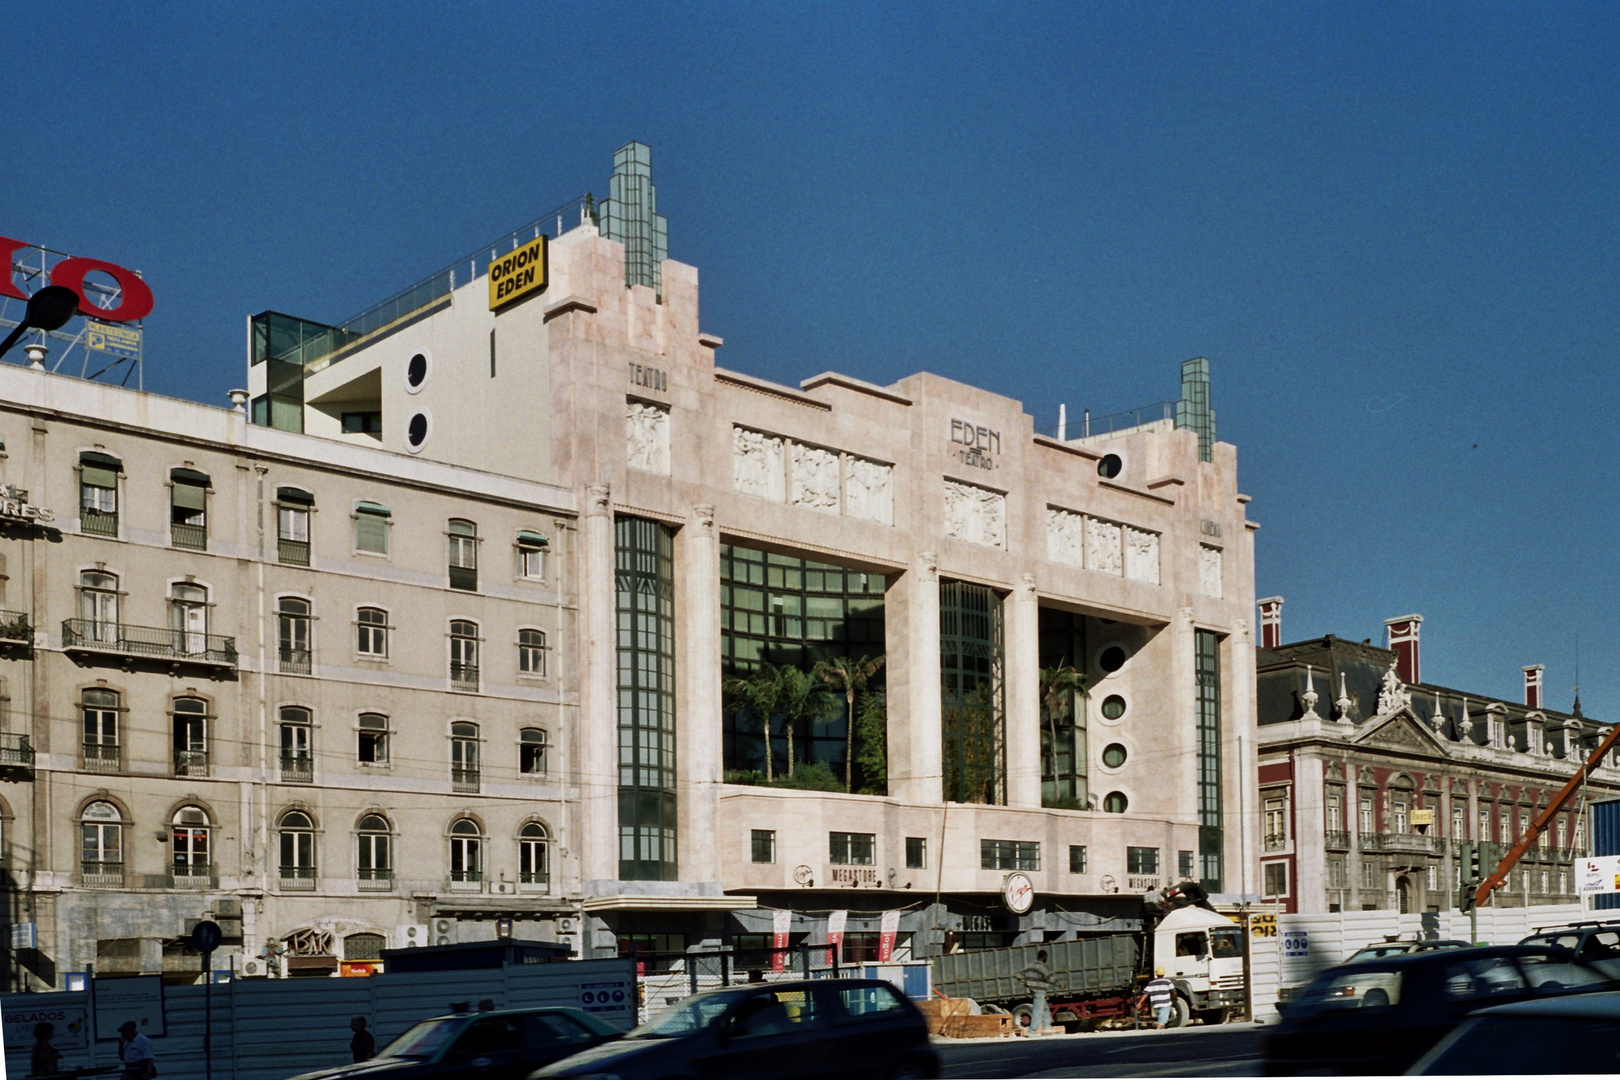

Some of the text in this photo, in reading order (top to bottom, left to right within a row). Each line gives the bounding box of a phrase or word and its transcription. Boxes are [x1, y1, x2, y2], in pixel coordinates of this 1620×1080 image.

[491, 243, 540, 282] ORION
[496, 266, 535, 300] EDEN
[629, 362, 667, 392] TEATRO
[951, 418, 1000, 455] EDEN
[959, 449, 993, 471] TEATRO
[832, 868, 877, 883] MEGASTORE
[5, 1011, 66, 1024] GELADOS
